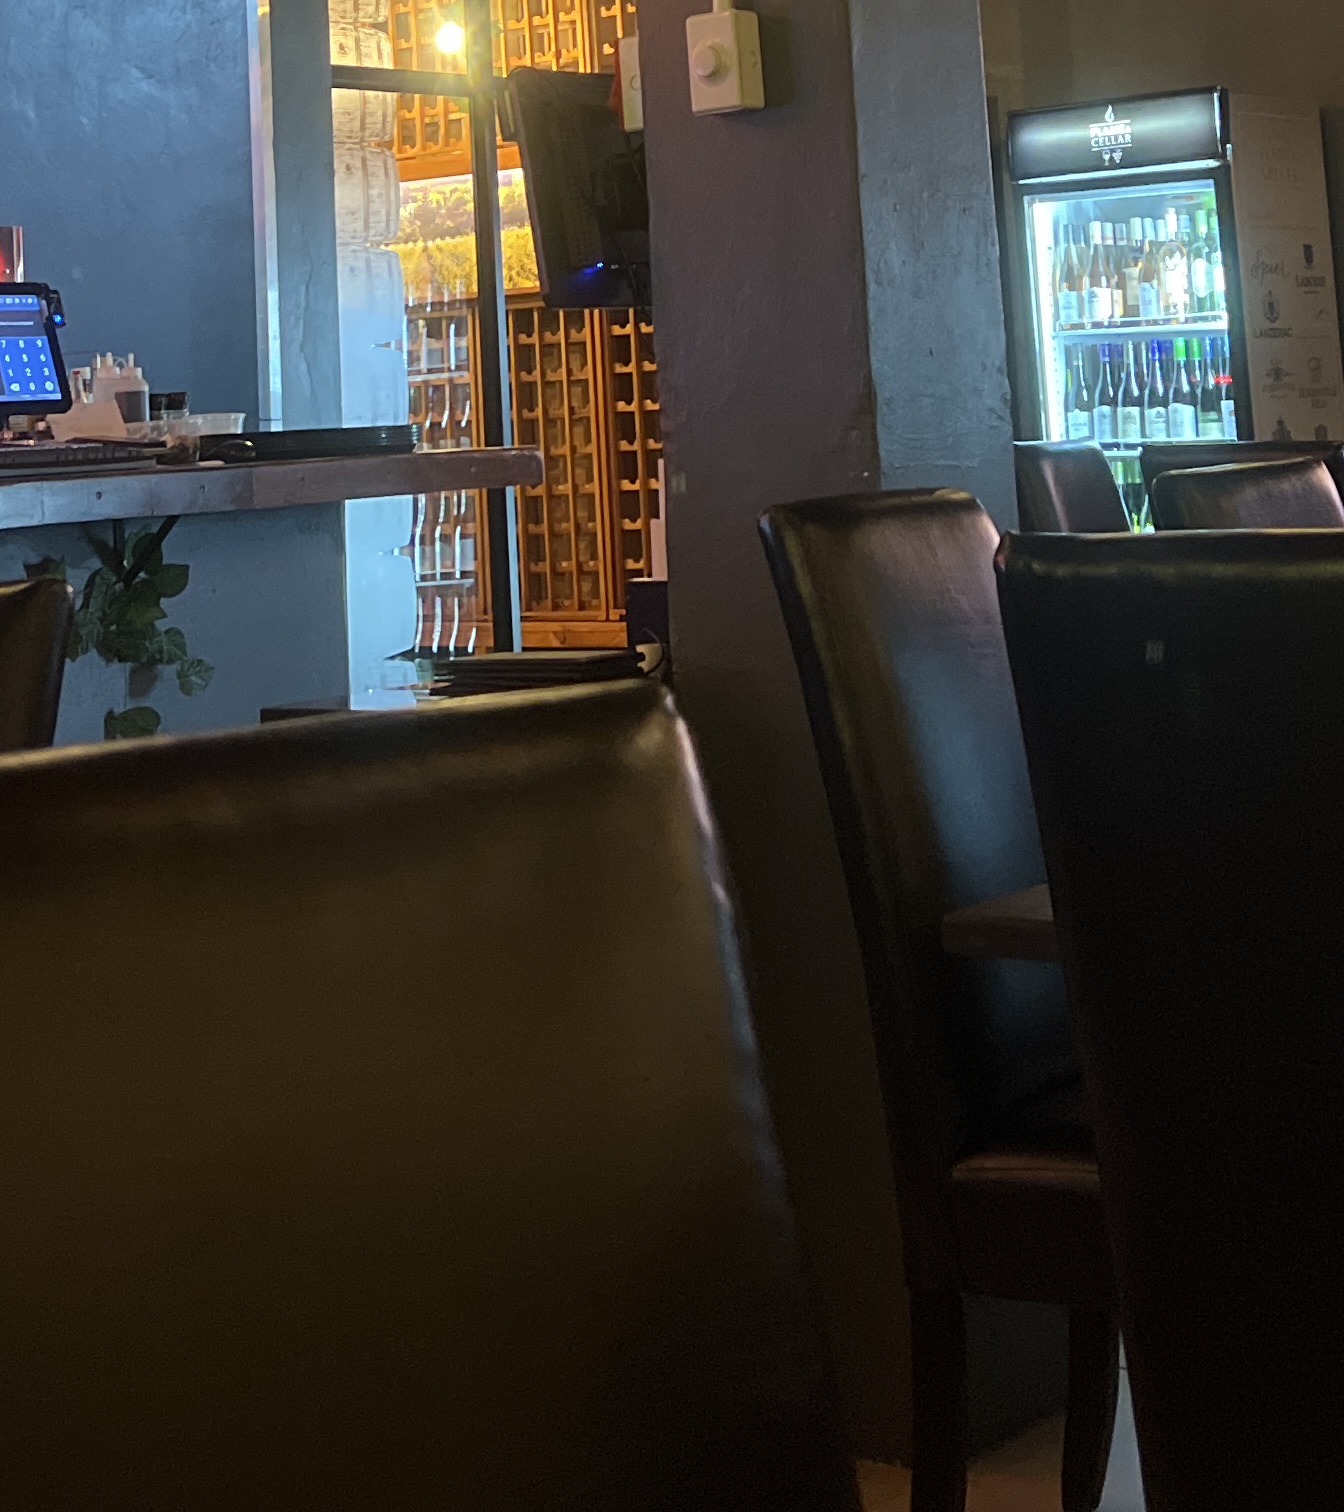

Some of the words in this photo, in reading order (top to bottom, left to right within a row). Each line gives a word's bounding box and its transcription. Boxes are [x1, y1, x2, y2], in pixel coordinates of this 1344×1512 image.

[1090, 133, 1132, 147] CELLAR
[1, 339, 6, 348] 7
[36, 339, 42, 348] 9
[25, 367, 32, 377] 2
